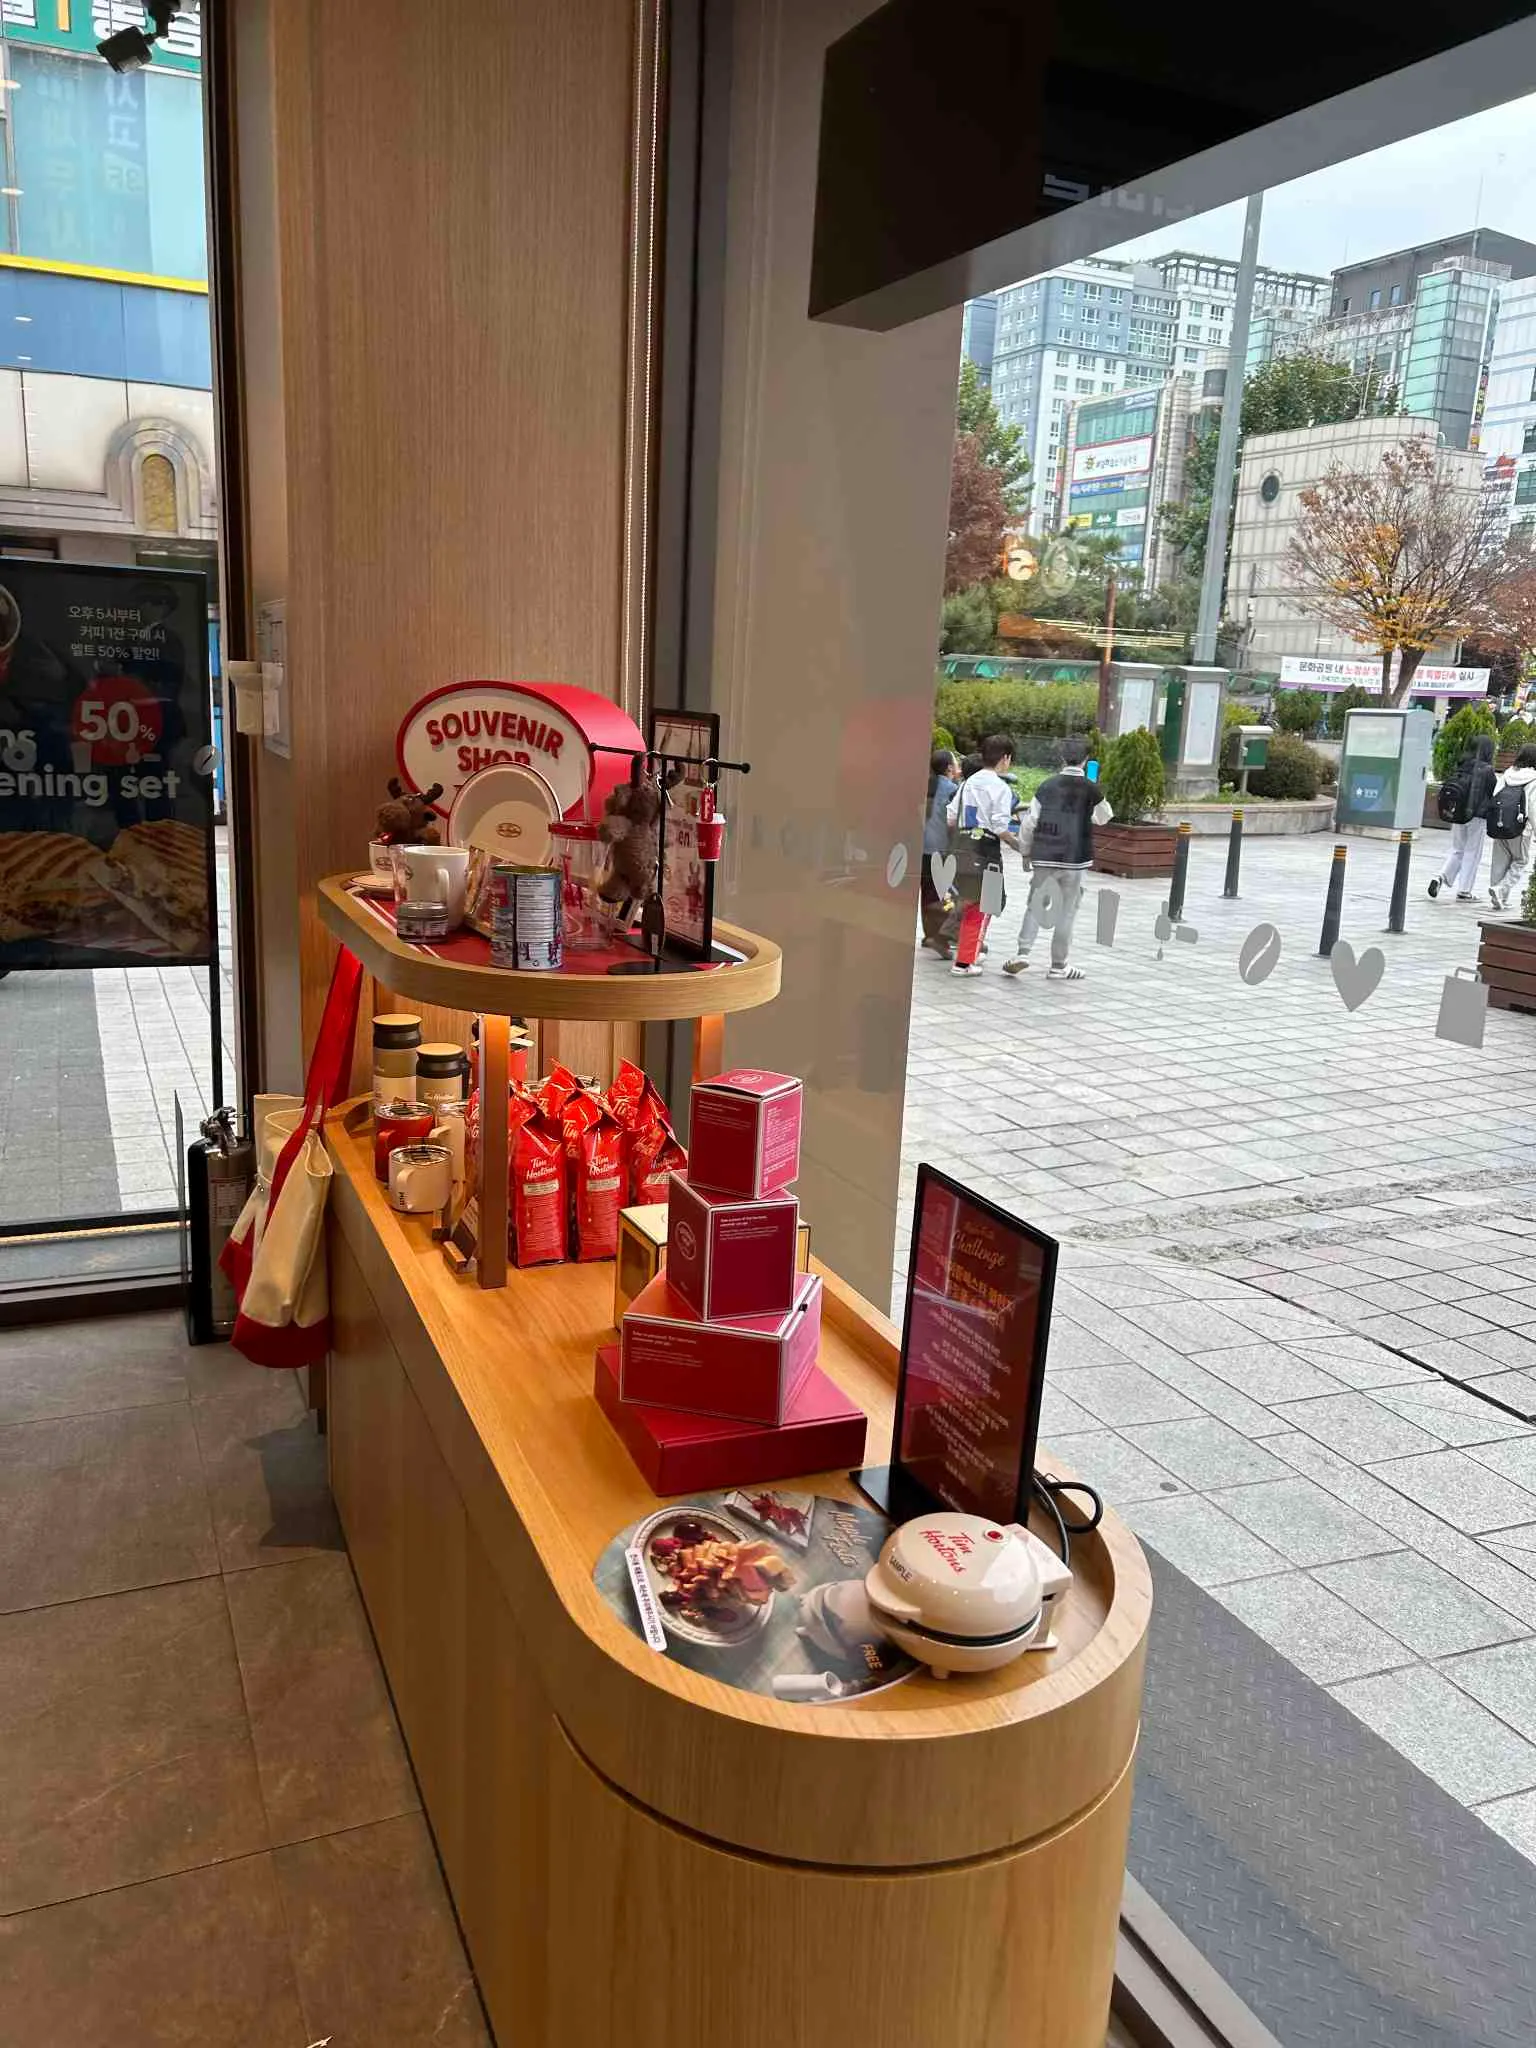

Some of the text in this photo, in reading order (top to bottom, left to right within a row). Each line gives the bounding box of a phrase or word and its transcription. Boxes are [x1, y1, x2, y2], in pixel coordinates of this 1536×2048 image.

[68, 606, 141, 623] 오후 5시부터
[80, 625, 105, 640] 커피
[107, 627, 126, 640] 1잔
[153, 630, 166, 643] 시
[98, 645, 130, 658] 50%
[131, 646, 160, 661] 할인!
[1335, 663, 1344, 674] 내
[79, 701, 157, 742] 50%
[426, 710, 564, 759] SOUVENIR
[120, 770, 181, 799] set
[531, 1157, 547, 1169] Tim
[918, 1529, 967, 1574] Hortons
[948, 1531, 975, 1555] Tim
[889, 1556, 913, 1582] SAMPLE
[860, 1643, 884, 1671] FREE
